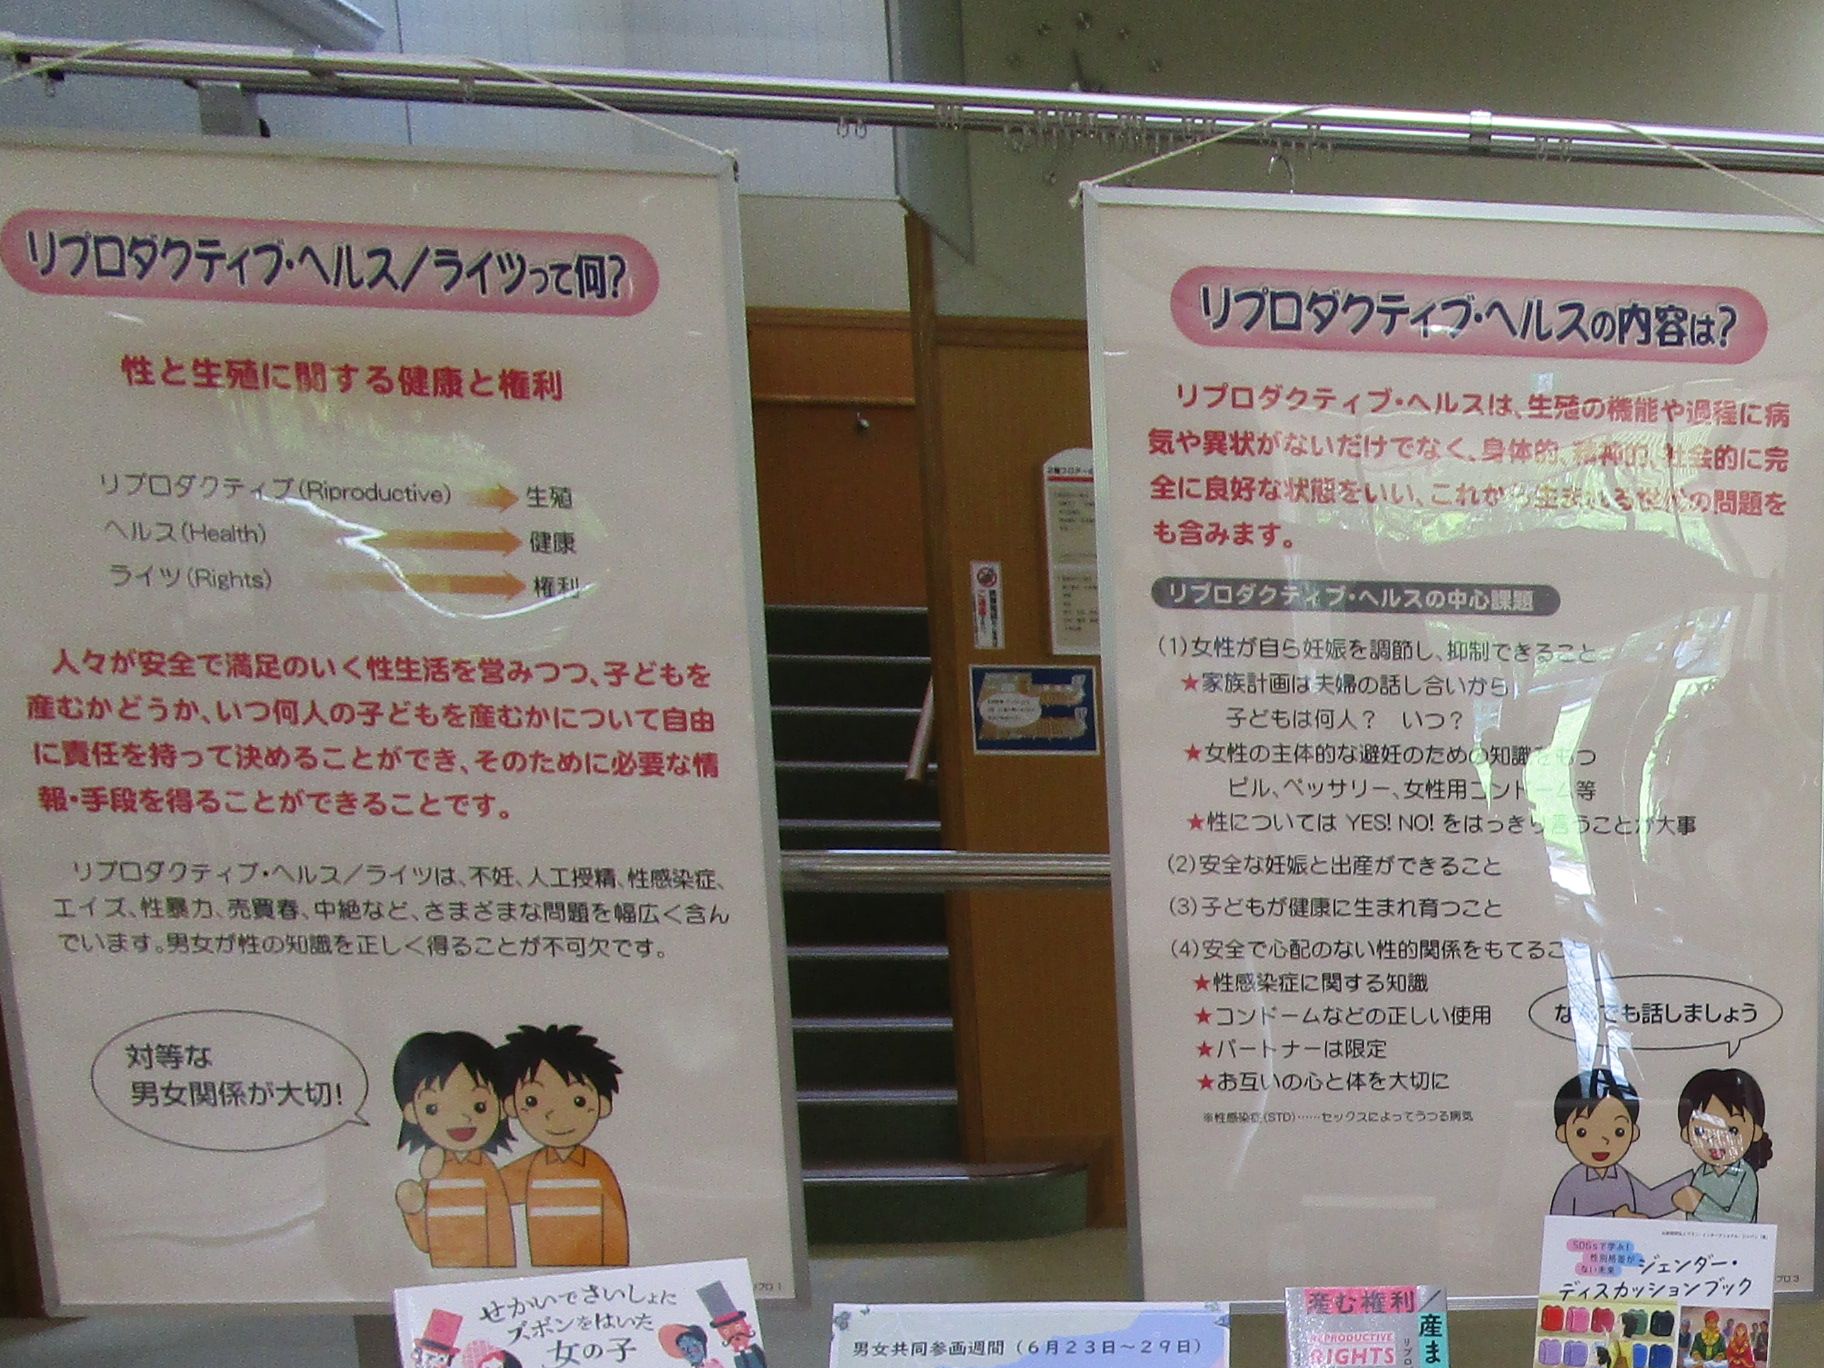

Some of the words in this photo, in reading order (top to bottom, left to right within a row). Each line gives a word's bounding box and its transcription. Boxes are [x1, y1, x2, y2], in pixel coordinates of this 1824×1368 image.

[1201, 284, 1738, 348] リプロダクティブ・ヘルスの内容は?
[121, 353, 564, 401] 性と生殖に関する健康と権利
[1177, 384, 1791, 429] リプロダクティブ・ヘルスは、生殖の機能や過程に病
[526, 485, 573, 510] 生殖
[529, 530, 577, 557] 健康
[1153, 521, 1297, 550] も含みます。
[533, 574, 581, 599] 権利
[1169, 582, 1533, 613] リプロダクティブ・ヘルスの中心課題
[53, 649, 713, 689] 人々が安全で満足のいく性生活を営みつつ、子どもを
[1202, 672, 1508, 697] 家族計画は夫婦の話し合いから
[26, 694, 716, 733] 産むかどうか、いつ何人の子どもを産むかについて自由
[34, 740, 719, 780] に責任を持って決めることができ、そのために必要な情
[38, 786, 511, 819] 報・手段を得ることができることです。
[1207, 812, 1338, 832] 性については
[1346, 813, 1392, 832] YES!
[1398, 813, 1435, 832] NO!
[59, 931, 667, 960] でいます。男女が性の知識を正しく得ることが不可欠です。
[1170, 937, 1584, 962] (4)安全で心配のない性的関係をもてるこ
[1213, 971, 1428, 995] 性感染症に関する知識
[1215, 1004, 1492, 1028] コンドームなどの正しい使用
[1554, 1003, 1759, 1025] なでも話しましょう
[126, 1042, 213, 1070] 対等な
[1215, 1038, 1387, 1061] パートナーは限定
[1216, 1070, 1450, 1094] お互いの心と体を大切に
[1559, 1276, 1753, 1302] ディスカッションブック
[507, 1312, 655, 1345] ズボンをはいた
[1310, 1347, 1395, 1367] RIGHTS
